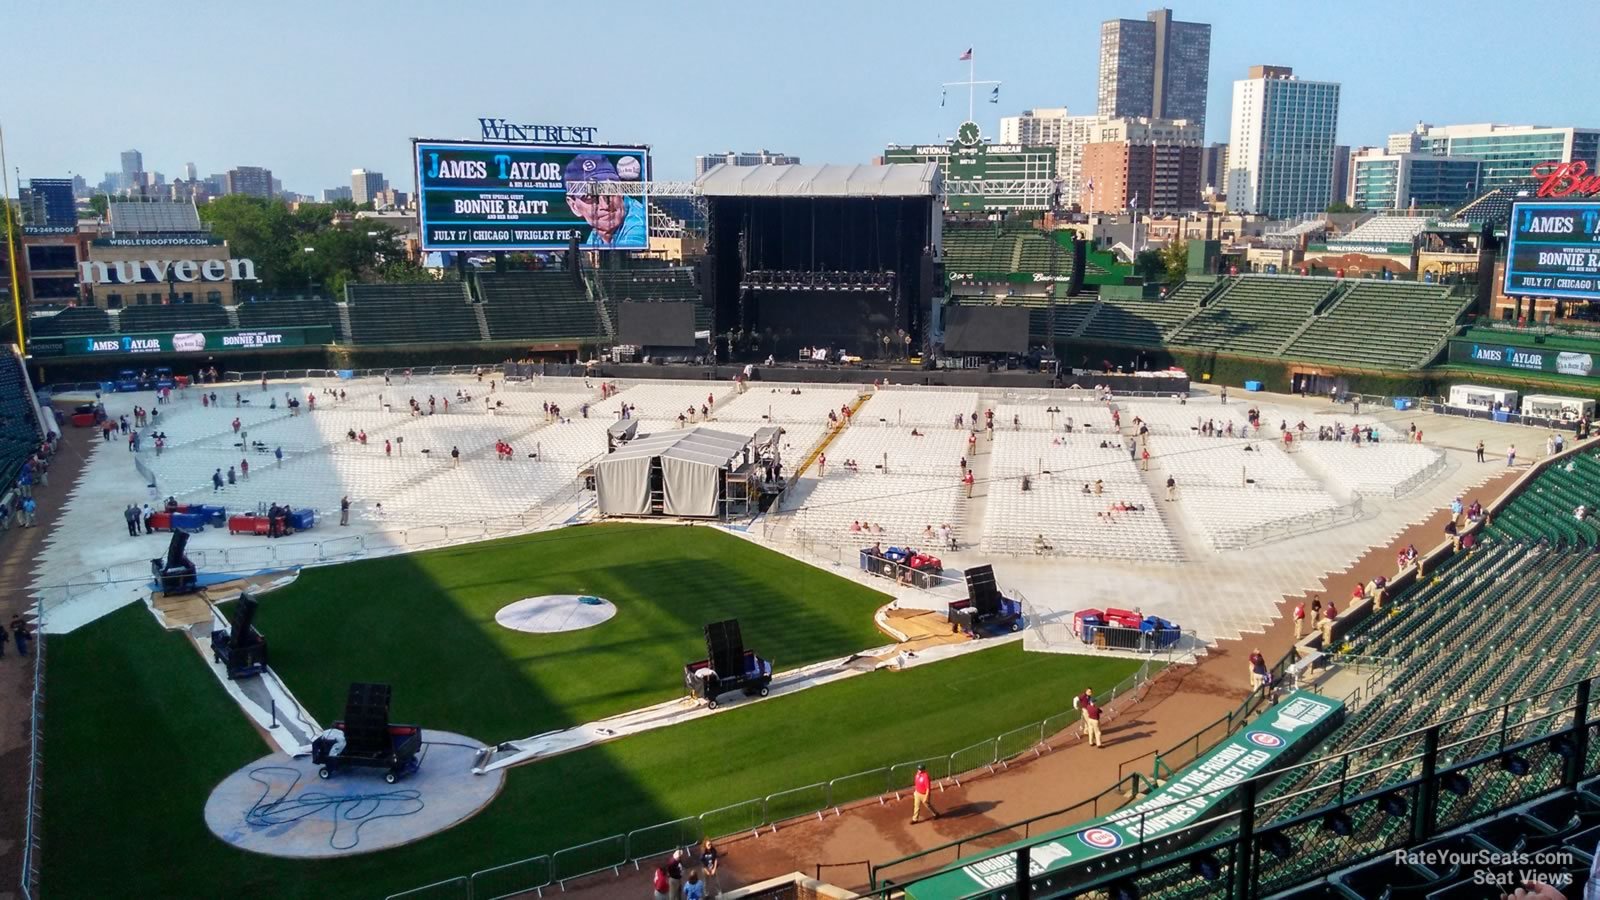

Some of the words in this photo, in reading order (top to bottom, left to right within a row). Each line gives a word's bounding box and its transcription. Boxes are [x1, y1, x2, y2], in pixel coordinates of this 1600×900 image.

[478, 118, 598, 143] WINTRUST
[427, 153, 487, 179] JAMES
[494, 154, 562, 181] TAYLOR
[454, 200, 504, 214] BONNIE
[508, 200, 548, 214] RAITT
[1520, 210, 1574, 233] JAMES
[434, 231, 456, 240] JULY
[458, 231, 467, 240] 17
[473, 231, 509, 240] CHICAGO
[515, 230, 555, 240] WRIGLEY
[1538, 252, 1585, 266] BONNIE
[78, 258, 258, 284] nuveen
[1522, 277, 1542, 286] JULY
[1544, 278, 1552, 287] 17
[1557, 278, 1591, 289] CHICAGO
[87, 338, 120, 351] JAMES
[122, 336, 160, 350] TAYLOR
[223, 336, 254, 346] BONNIE
[256, 335, 282, 343] RAITT
[1472, 344, 1501, 360] JAMES
[1505, 348, 1542, 365] TAYLOR
[1104, 793, 1180, 826] WELCOME
[1166, 782, 1193, 796] TO
[1180, 770, 1212, 787] THE
[1198, 742, 1248, 774] FRIENDLY
[1126, 804, 1197, 838] CONFINES
[1198, 765, 1248, 798] WRIGLEY
[1236, 750, 1271, 770] FIELD
